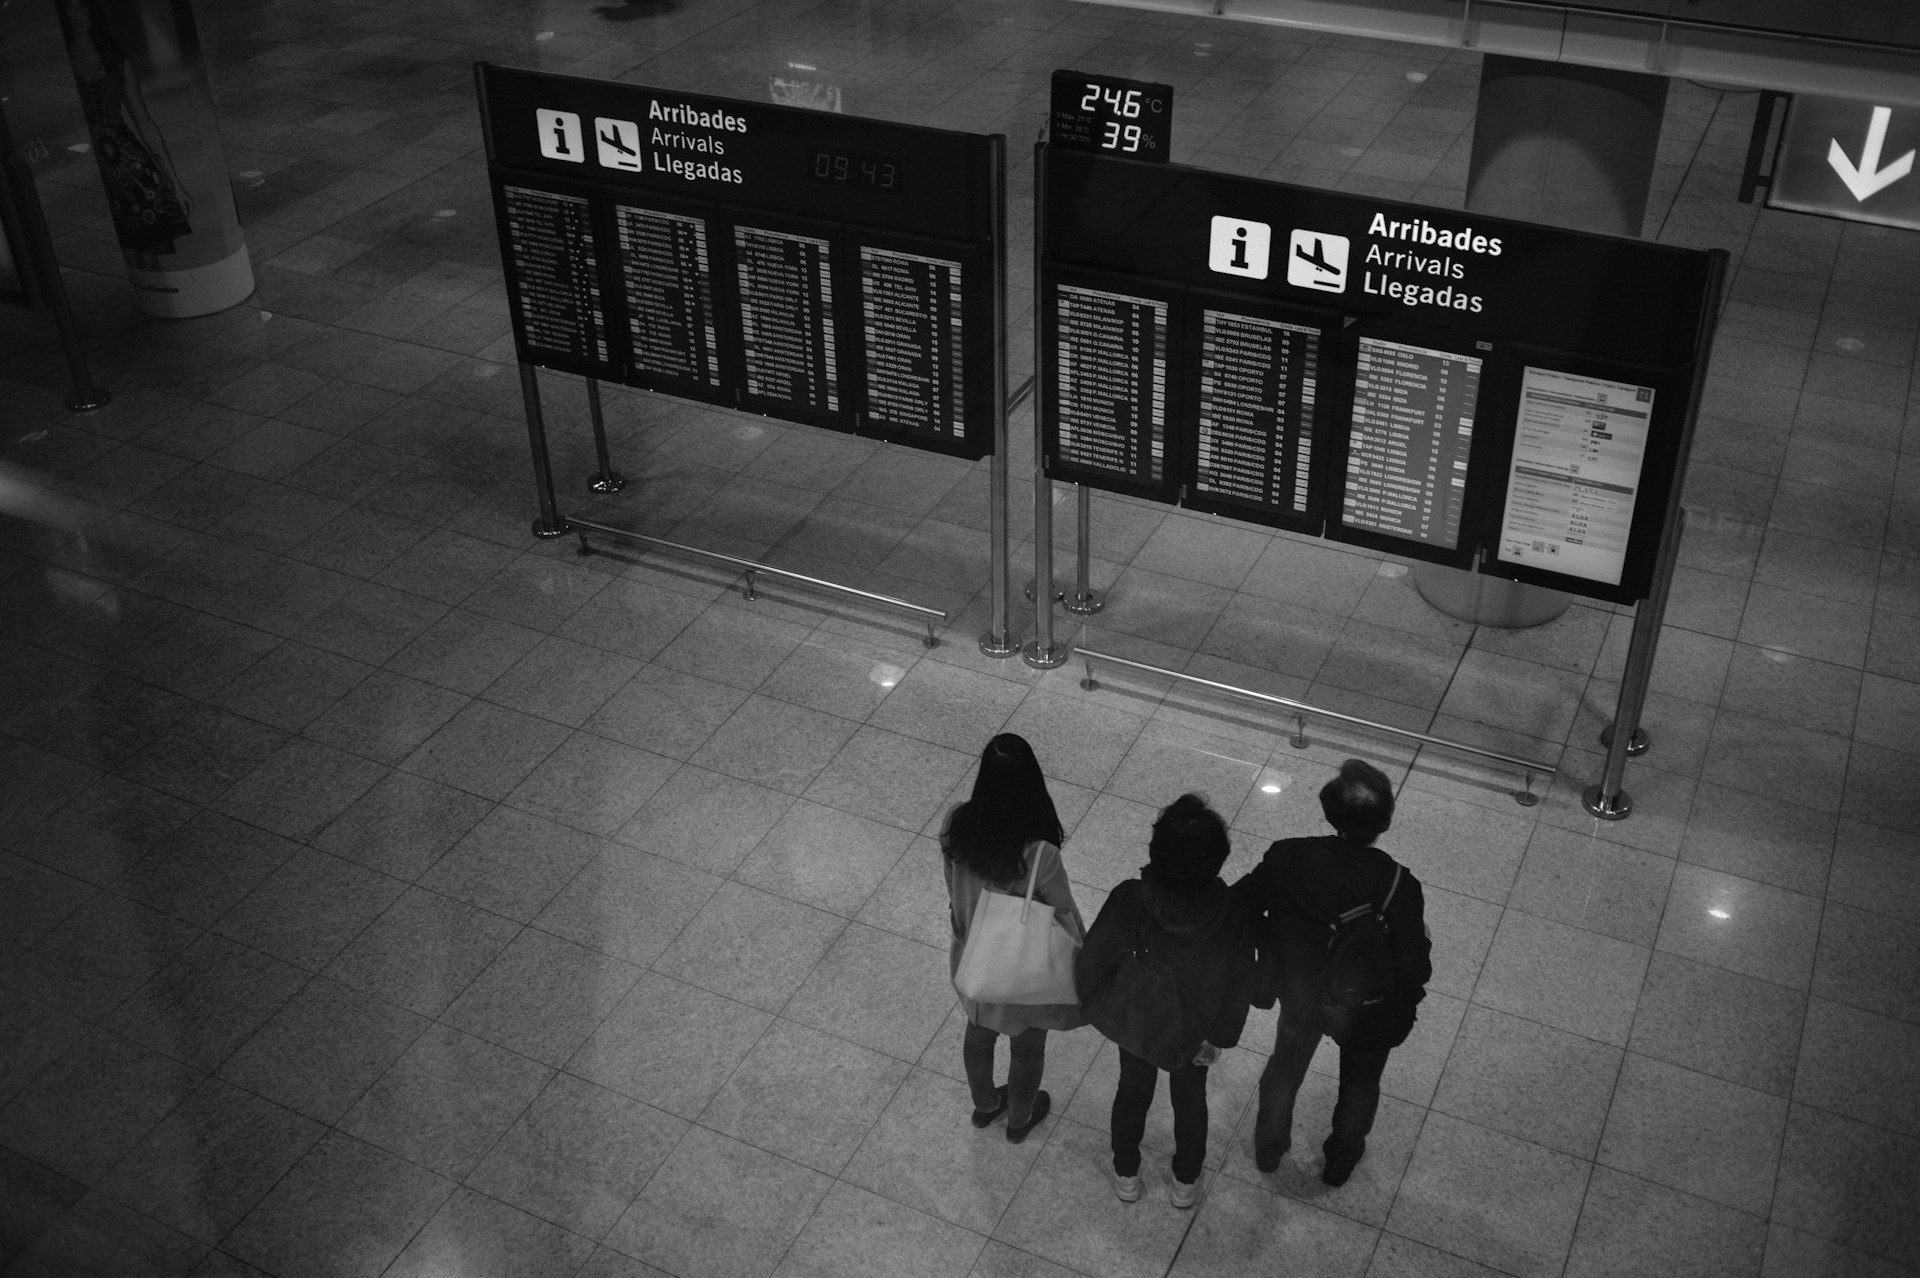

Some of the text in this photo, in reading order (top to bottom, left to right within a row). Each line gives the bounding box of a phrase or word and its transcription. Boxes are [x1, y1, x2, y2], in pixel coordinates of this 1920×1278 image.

[1081, 84, 1162, 118] 24.6 °C
[649, 100, 747, 133] Arribades
[651, 127, 724, 155] Arrivals
[1102, 122, 1155, 153] 39 %
[654, 151, 743, 184] Llegadas
[1368, 212, 1503, 256] Arribades
[1366, 244, 1465, 279] Arrivals
[1363, 271, 1483, 313] Llegadas
[1092, 297, 1116, 306] ATENAS
[1092, 306, 1115, 315] ATENAS
[1240, 323, 1273, 334] ESTAMBUL
[1240, 332, 1272, 343] BRUSELAS
[1239, 340, 1272, 352] BRUSELAS
[1239, 349, 1272, 360] PARIS/CDG
[1397, 352, 1414, 360] OSLO
[1238, 358, 1271, 369] PARIS/CDG
[1396, 360, 1419, 370] MADRID
[1238, 367, 1264, 376] OPORTO
[1395, 370, 1428, 381] FLORENCIA
[1237, 375, 1263, 385] OPORTO
[1394, 378, 1427, 390] FLORENCIA
[1237, 384, 1263, 394] OPORTO
[1236, 392, 1262, 402] OPORTO
[1236, 409, 1254, 417] ROMA
[1391, 405, 1426, 416] FRANKFURT
[1235, 417, 1254, 426] ROMA
[1390, 414, 1424, 425] FRANKFURT
[1235, 426, 1267, 437] PARIS/CDG
[1389, 422, 1410, 431] LISBOA
[1234, 434, 1266, 445] PARIS/CDG
[1388, 431, 1409, 440] LISBOA
[1234, 442, 1266, 453] PARIS/CDG
[1386, 448, 1407, 457] LISBOA
[1233, 450, 1265, 461] PARIS/CDG
[1233, 458, 1265, 469] PARIS/CDG
[1386, 457, 1406, 466] LISBOA
[1232, 466, 1264, 478] PARIS/CDG
[1384, 465, 1405, 474] LISBOA
[1232, 474, 1264, 486] PARIS/CDG
[1232, 482, 1263, 494] PARIS/CDG
[1231, 490, 1263, 501] PARIS/CDG
[1380, 506, 1402, 515] MUNICH
